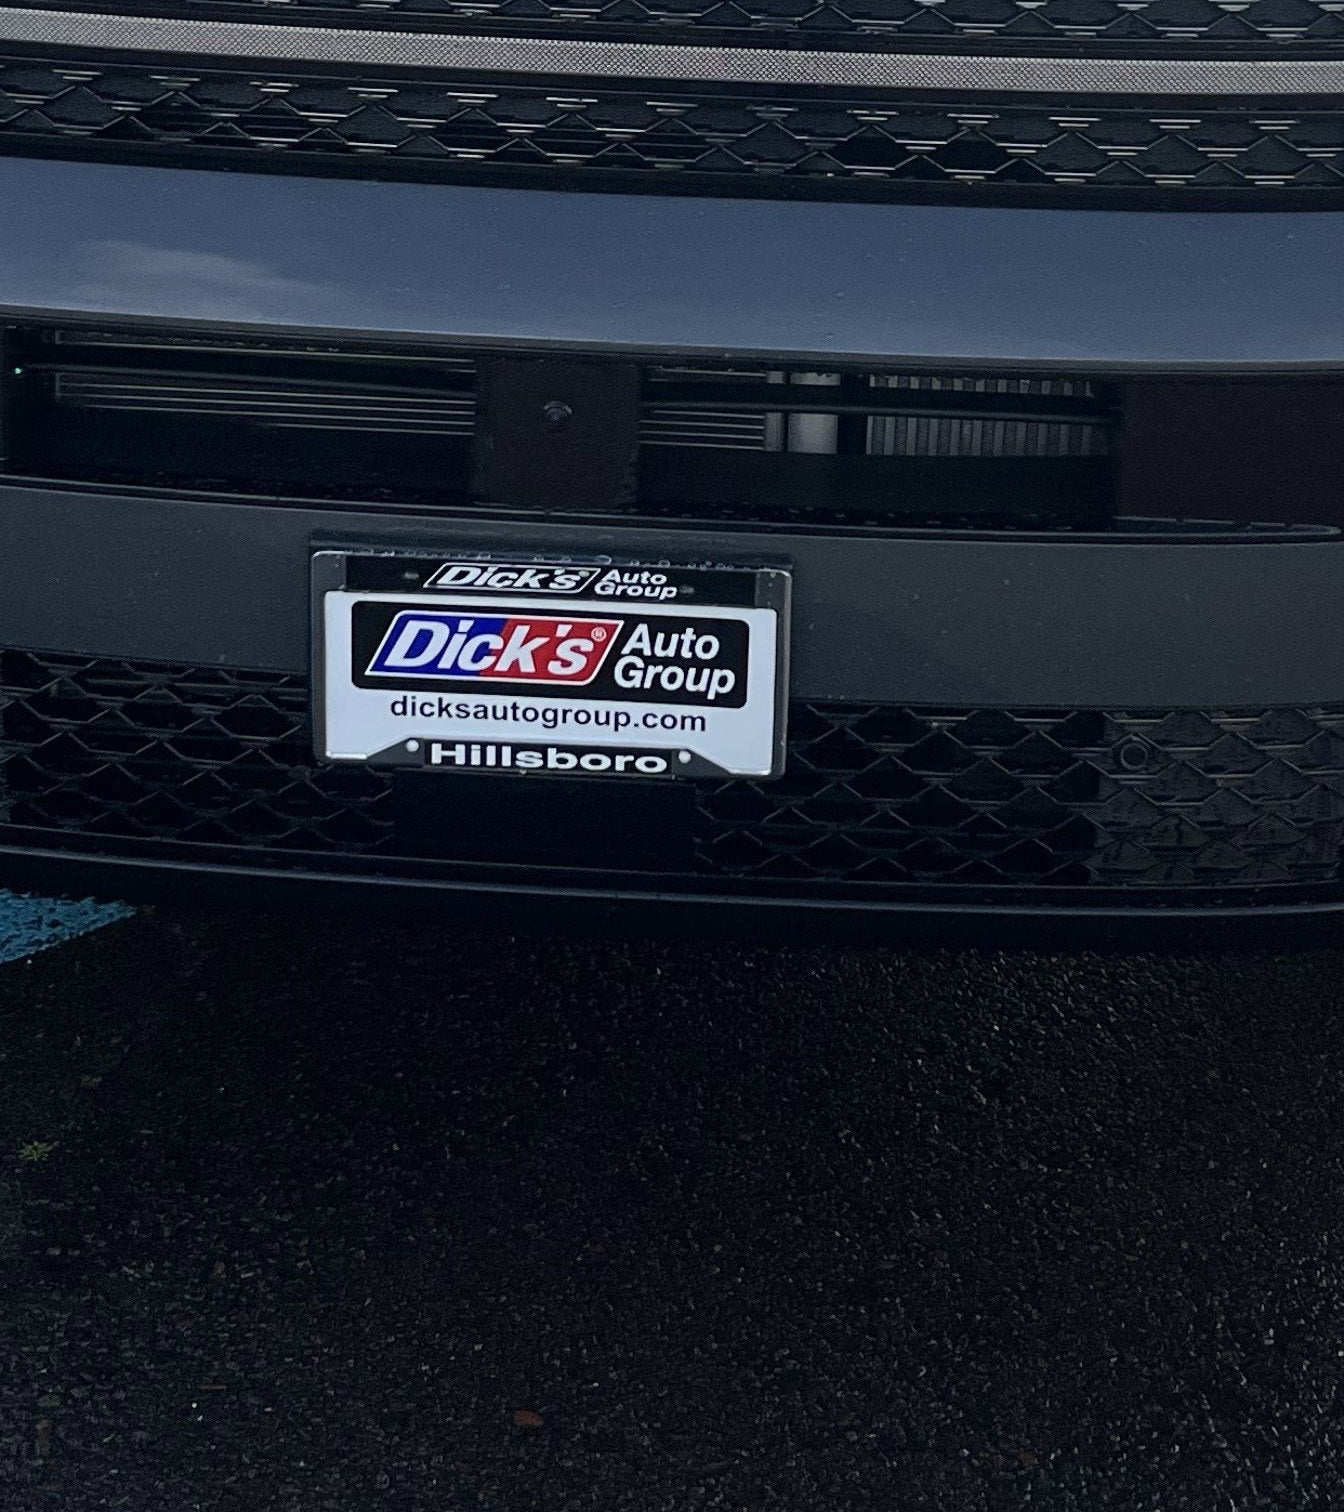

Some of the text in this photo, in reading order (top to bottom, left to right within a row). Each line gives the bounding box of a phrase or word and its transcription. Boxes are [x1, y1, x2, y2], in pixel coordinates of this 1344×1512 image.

[594, 581, 677, 601] Group
[601, 569, 667, 586] Auto
[620, 622, 720, 660] Auto
[613, 655, 736, 700] Group
[390, 695, 707, 733] dicksautogroup.com
[430, 741, 668, 774] Hillsboro
